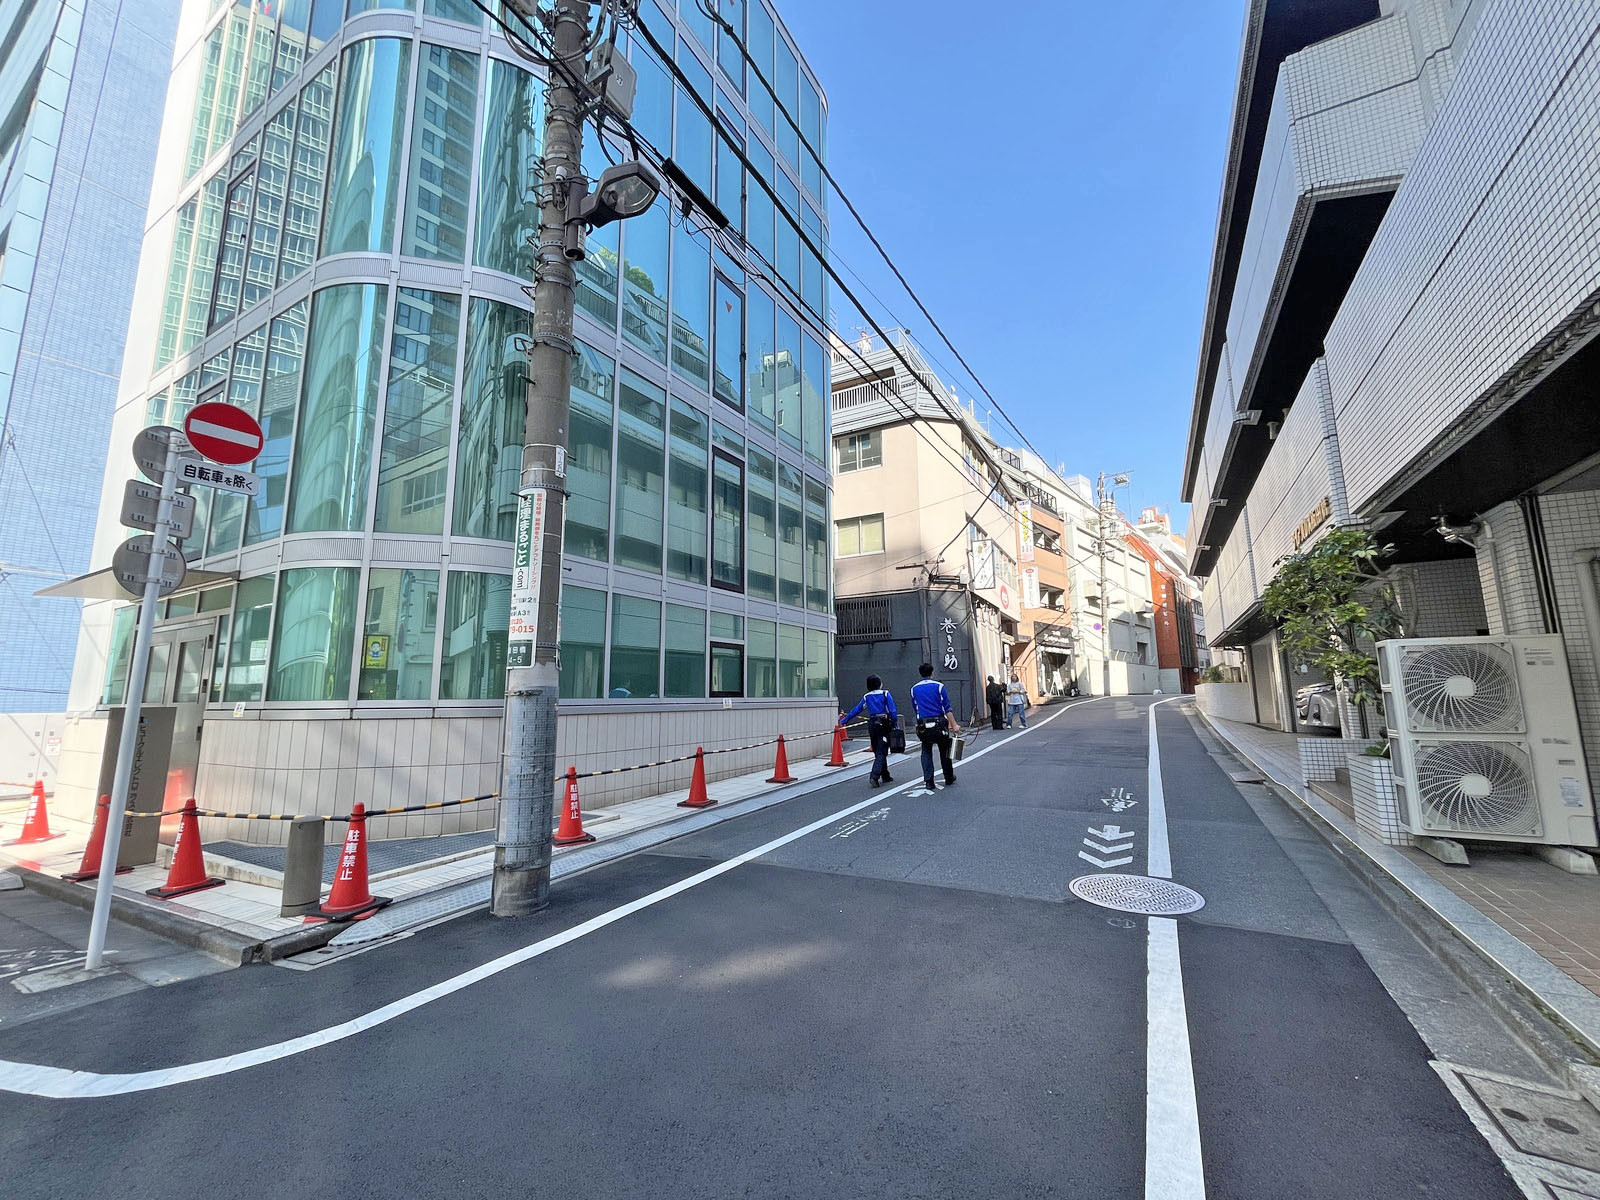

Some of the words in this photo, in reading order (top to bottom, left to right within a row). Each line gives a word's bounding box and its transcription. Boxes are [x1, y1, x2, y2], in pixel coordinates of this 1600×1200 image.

[184, 464, 252, 490] 自転車を除く
[940, 618, 958, 670] 巻きの助
[570, 784, 578, 820] 駐車禁止
[340, 830, 360, 880] 駐車禁止
